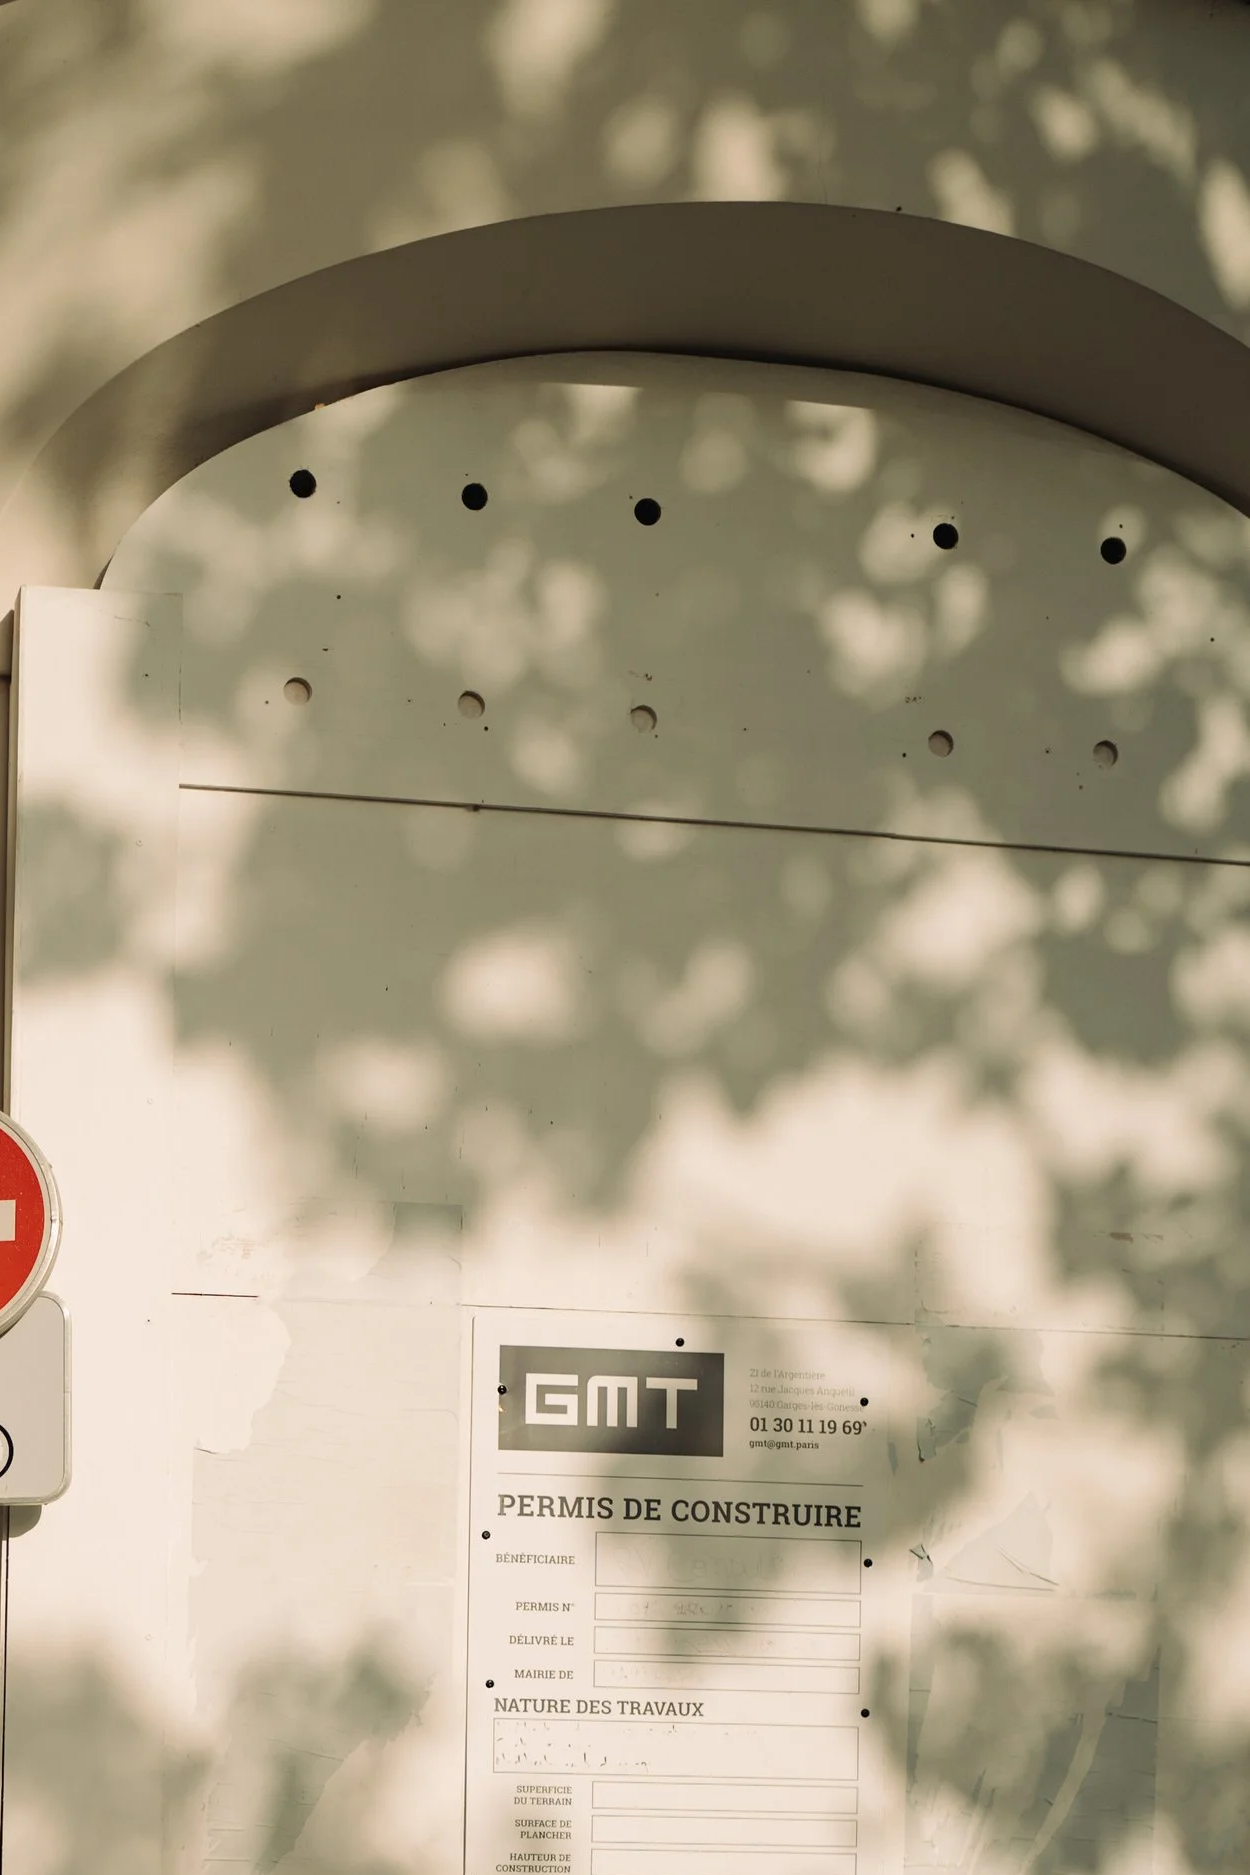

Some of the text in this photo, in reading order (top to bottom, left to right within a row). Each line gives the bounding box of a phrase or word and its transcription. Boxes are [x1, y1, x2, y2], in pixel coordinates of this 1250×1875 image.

[761, 1369, 772, 1379] de
[750, 1384, 760, 1394] 12
[761, 1385, 776, 1395] rue
[778, 1385, 815, 1397] Jacques
[525, 1372, 698, 1430] GMT
[750, 1416, 768, 1432] 01
[773, 1417, 793, 1433] 30
[798, 1418, 815, 1433] 11
[819, 1419, 837, 1434] 19
[749, 1439, 820, 1451] gmt@gmt.paris
[497, 1494, 862, 1529] PERMIS DE CONSTRUIRE
[495, 1552, 576, 1566] BÉNÉFICIAIRE
[515, 1601, 560, 1613] PERMIS
[508, 1633, 575, 1647] DÉLIVRÉ LE
[514, 1668, 574, 1681] MAIRIE DE
[494, 1696, 704, 1718] NATURE DES TRAVAUX
[516, 1785, 572, 1796] SUPERFICIE
[513, 1796, 572, 1807] DU TERRAIN
[514, 1818, 572, 1829] SURFACE DE
[519, 1830, 572, 1841] PLANCHER
[509, 1852, 572, 1863] HAUTEUR DE
[495, 1863, 571, 1874] CONSTRUCTION
